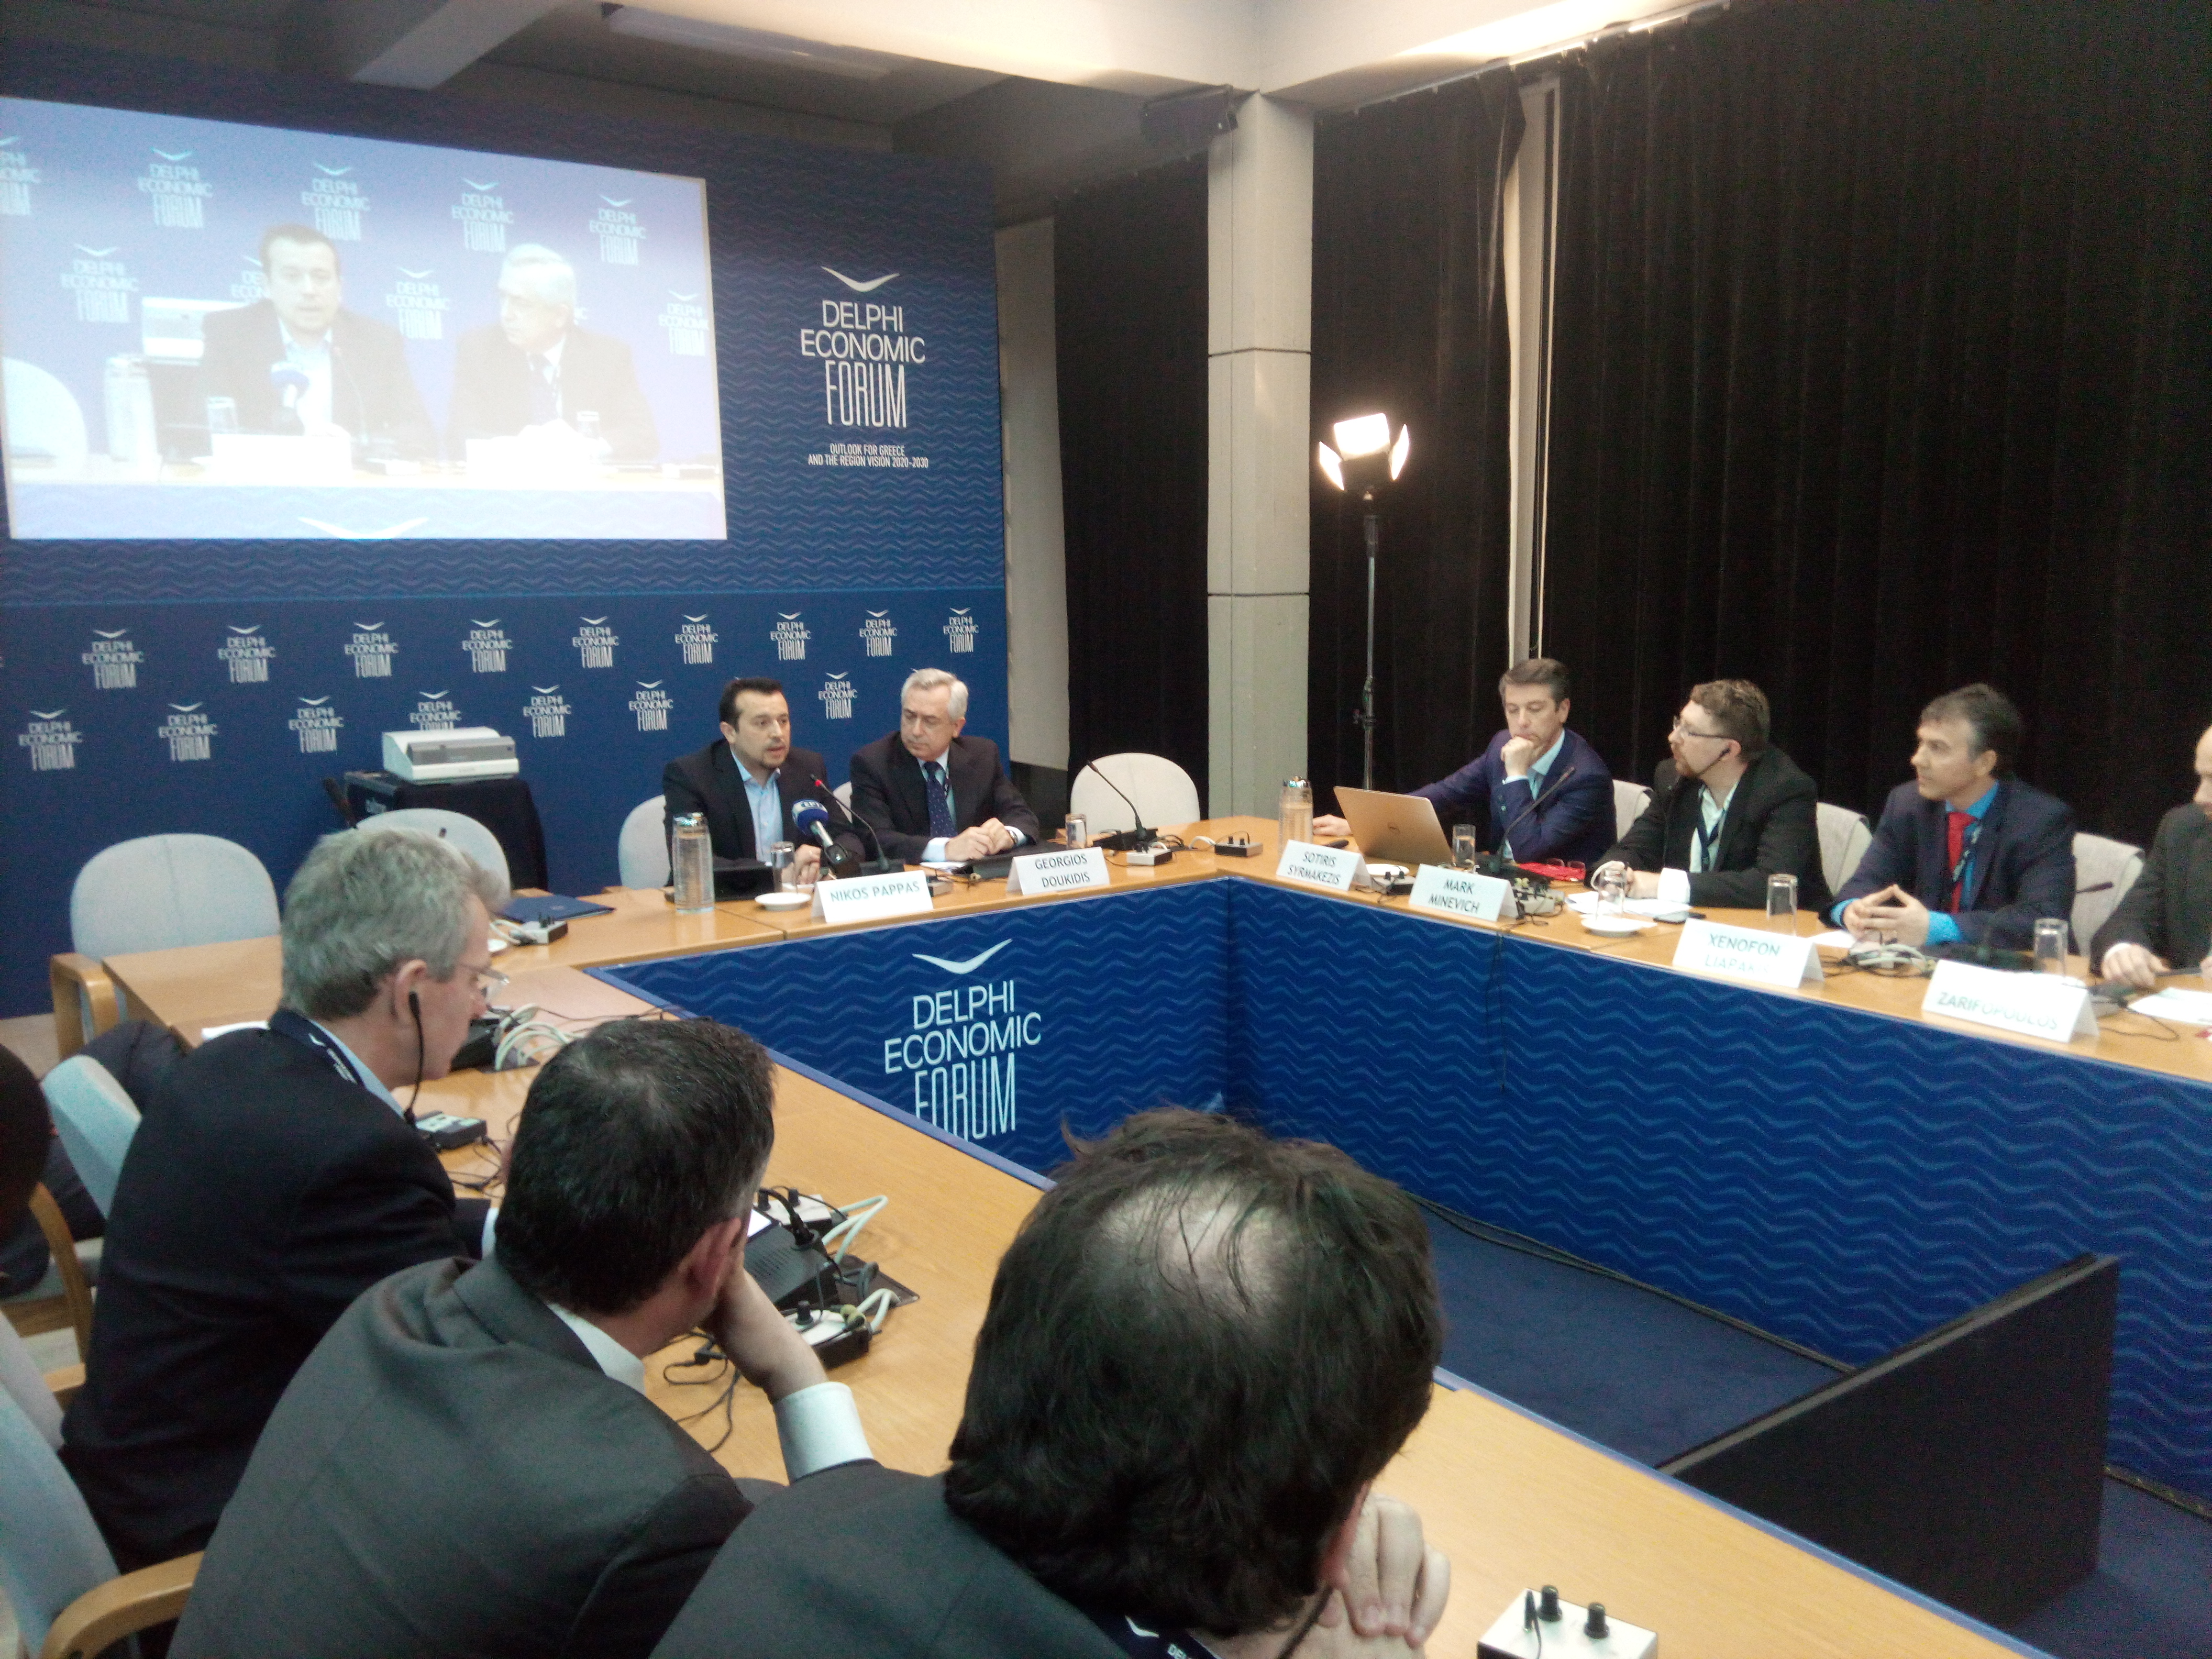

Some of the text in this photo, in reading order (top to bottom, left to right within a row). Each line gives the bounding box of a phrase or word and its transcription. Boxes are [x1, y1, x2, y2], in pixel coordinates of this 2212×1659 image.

[150, 163, 200, 181] DELPHI
[138, 178, 213, 197] ECONOMIC
[312, 178, 358, 194] DELPHI
[301, 192, 370, 211] ECONOMIC
[461, 194, 503, 208] DELPHI
[452, 206, 514, 224] ECONOMIC
[598, 209, 636, 224] DELPHI
[589, 220, 646, 239] ECONOMIC
[73, 260, 125, 276] DELPHI
[61, 274, 139, 292] ECONOMIC
[396, 282, 439, 297] DELPHI
[386, 295, 450, 312] ECONOMIC
[667, 303, 703, 317] DELPHI
[822, 300, 903, 333] DELPHI
[801, 328, 925, 363] ECONOMIC
[824, 360, 906, 428] FORUM
[830, 443, 905, 457] OUTLOOK FOR GREECE
[808, 454, 928, 468] AND THE REGION VISION 2020-2030
[777, 622, 804, 632] DELPHI
[866, 618, 891, 629] DELPHI
[949, 616, 972, 626] DELPHI
[470, 629, 503, 640] DELPHI
[580, 626, 611, 637] DELPHI
[682, 624, 711, 634] DELPHI
[770, 631, 811, 641] ECONOMIC
[859, 627, 898, 638] ECONOMIC
[943, 624, 979, 635] ECONOMIC
[227, 636, 265, 648] DELPHI
[352, 633, 389, 644] DELPHI
[462, 639, 513, 651] ECONOMIC
[572, 636, 620, 647] ECONOMIC
[675, 633, 718, 644] ECONOMIC
[217, 647, 276, 660] ECONOMIC
[344, 643, 399, 655] ECONOMIC
[825, 681, 850, 691] DELPHI
[530, 695, 563, 706] DELPHI
[636, 690, 666, 701] DELPHI
[818, 689, 858, 700] ECONOMIC
[418, 701, 453, 712] DELPHI
[524, 705, 571, 717] ECONOMIC
[628, 699, 673, 711] ECONOMIC
[825, 699, 852, 720] FORUM
[297, 707, 335, 719] DELPHI
[410, 710, 462, 723] ECONOMIC
[289, 717, 345, 730] ECONOMIC
[532, 715, 565, 738] FORUM
[637, 709, 667, 732] FORUM
[1035, 854, 1088, 870] GEORGIOS
[1302, 851, 1337, 868] SOTIRIS
[1042, 871, 1091, 889] DOUKIDIS
[1287, 864, 1341, 886] SYRMAKEZIS
[831, 881, 920, 903] NIKOS PAPPAS
[1443, 879, 1476, 894] MARK
[1428, 893, 1480, 914] MINEVICH
[1708, 933, 1780, 957] XENOFON
[913, 980, 1015, 1030] DELPHI
[1938, 991, 2058, 1030] ZARIFOPOULOS
[884, 1012, 1042, 1075] ECONOMIC
[915, 1053, 1016, 1142] FORUM
